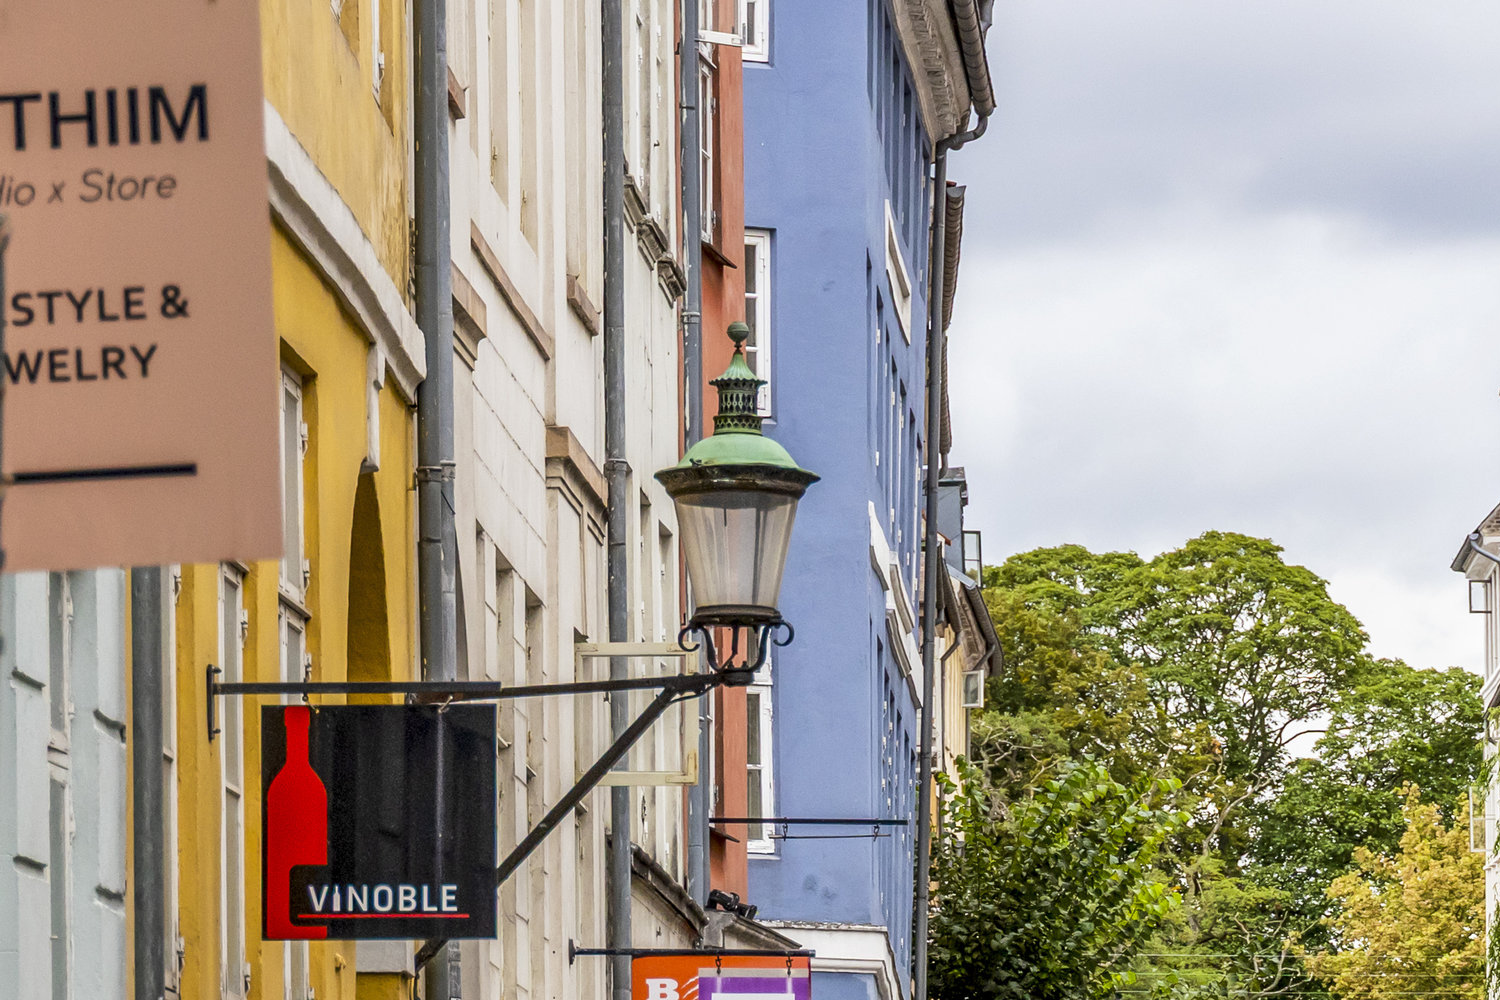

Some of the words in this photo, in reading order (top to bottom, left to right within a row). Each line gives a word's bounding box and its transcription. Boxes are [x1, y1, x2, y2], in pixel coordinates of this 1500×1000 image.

[0, 82, 209, 151] THIIM
[79, 167, 178, 204] Store
[3, 287, 147, 327] STYLE
[160, 284, 190, 318] &
[308, 884, 458, 913] VINOBLE
